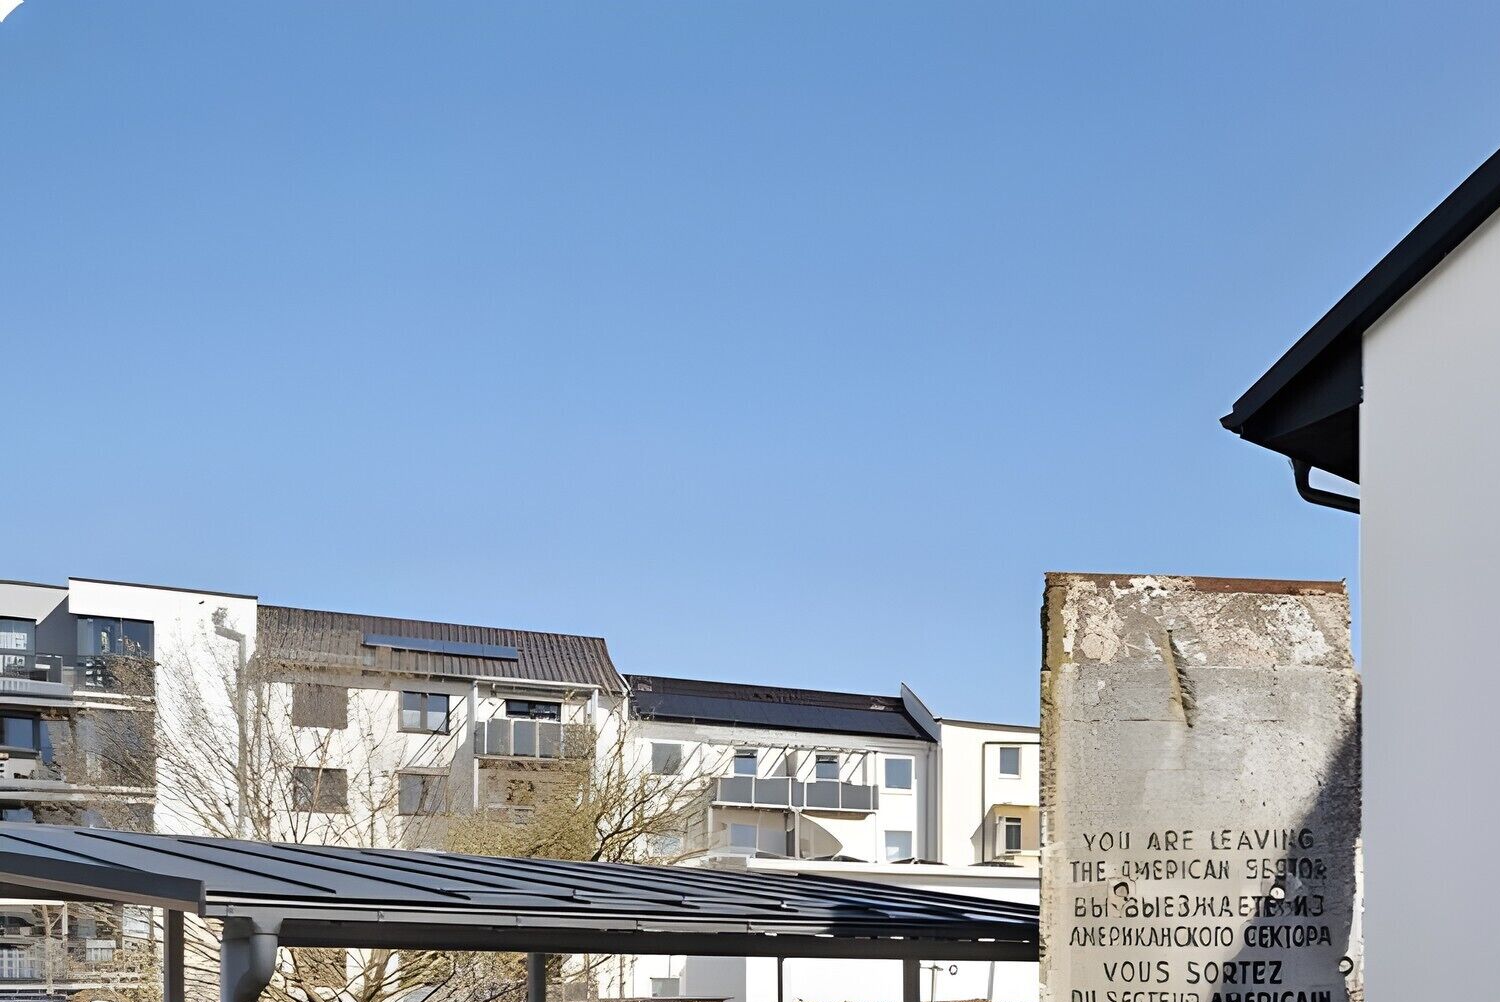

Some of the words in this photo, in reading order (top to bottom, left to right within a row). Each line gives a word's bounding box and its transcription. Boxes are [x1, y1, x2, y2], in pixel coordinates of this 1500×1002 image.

[1083, 830, 1130, 851] YOU
[1147, 830, 1193, 851] ARE
[1211, 828, 1314, 850] LEAVING
[1070, 860, 1106, 882] THE
[1122, 859, 1229, 880] AMERICAN
[1075, 897, 1108, 917] ВЫ
[1294, 895, 1324, 917] ИЗ
[1244, 925, 1332, 948] СЕКТОРА
[1104, 961, 1169, 983] VOUS
[1186, 961, 1282, 984] SORTEZ
